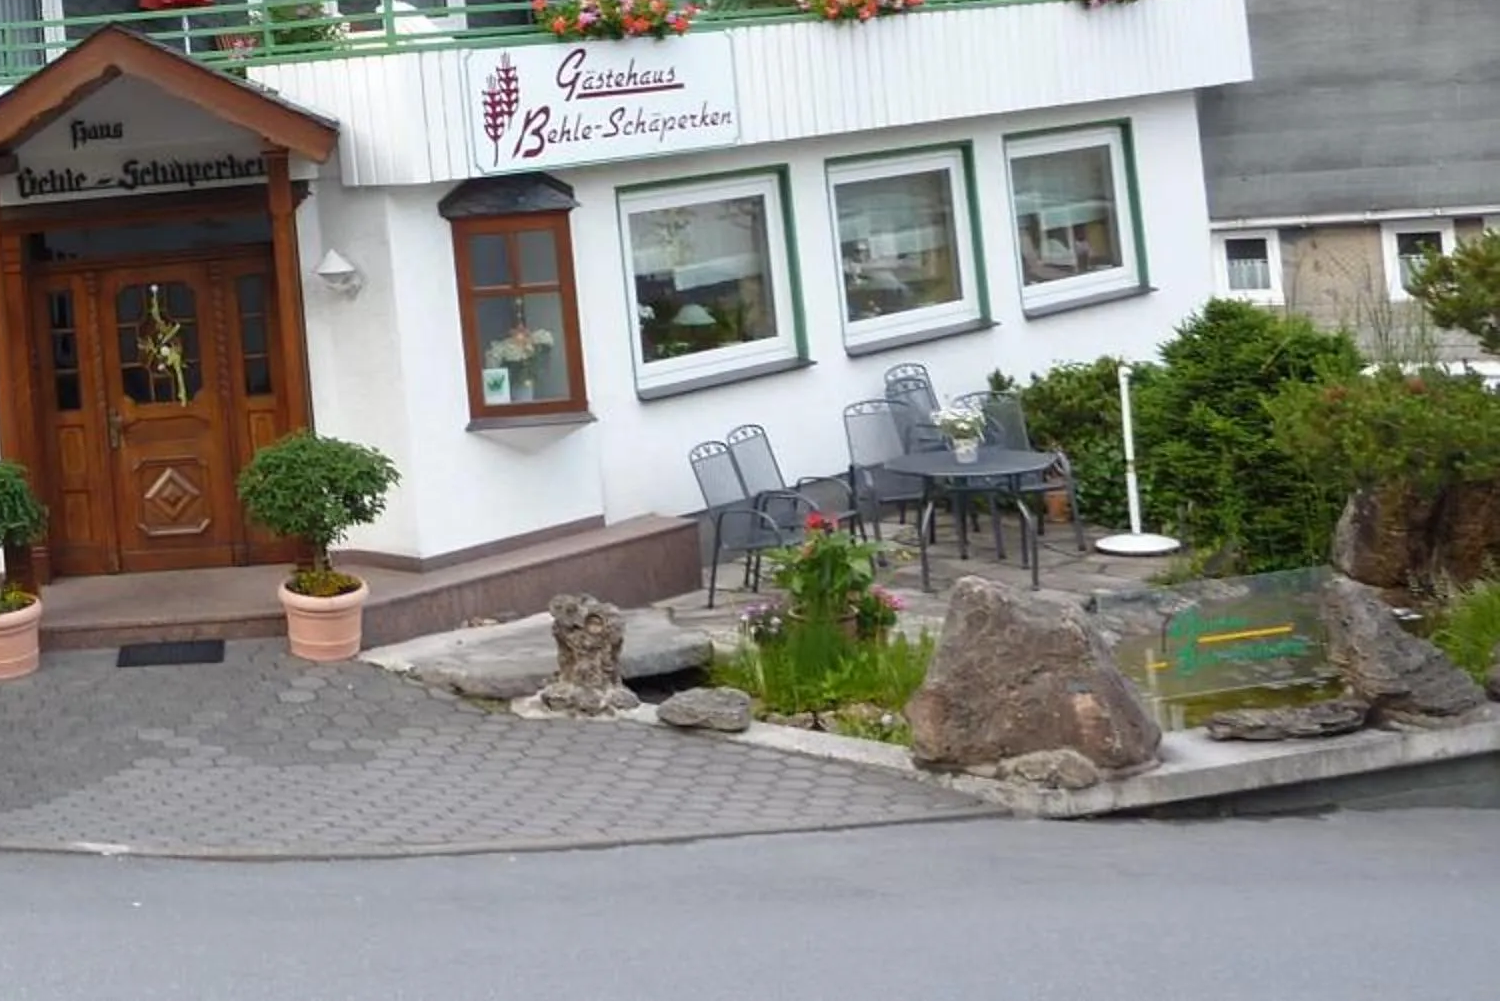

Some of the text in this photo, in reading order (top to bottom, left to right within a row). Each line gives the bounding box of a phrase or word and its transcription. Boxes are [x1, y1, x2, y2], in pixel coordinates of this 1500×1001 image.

[556, 49, 676, 101] Gästehaus
[70, 120, 123, 150] Haus
[512, 101, 734, 158] Behle-Schäperken
